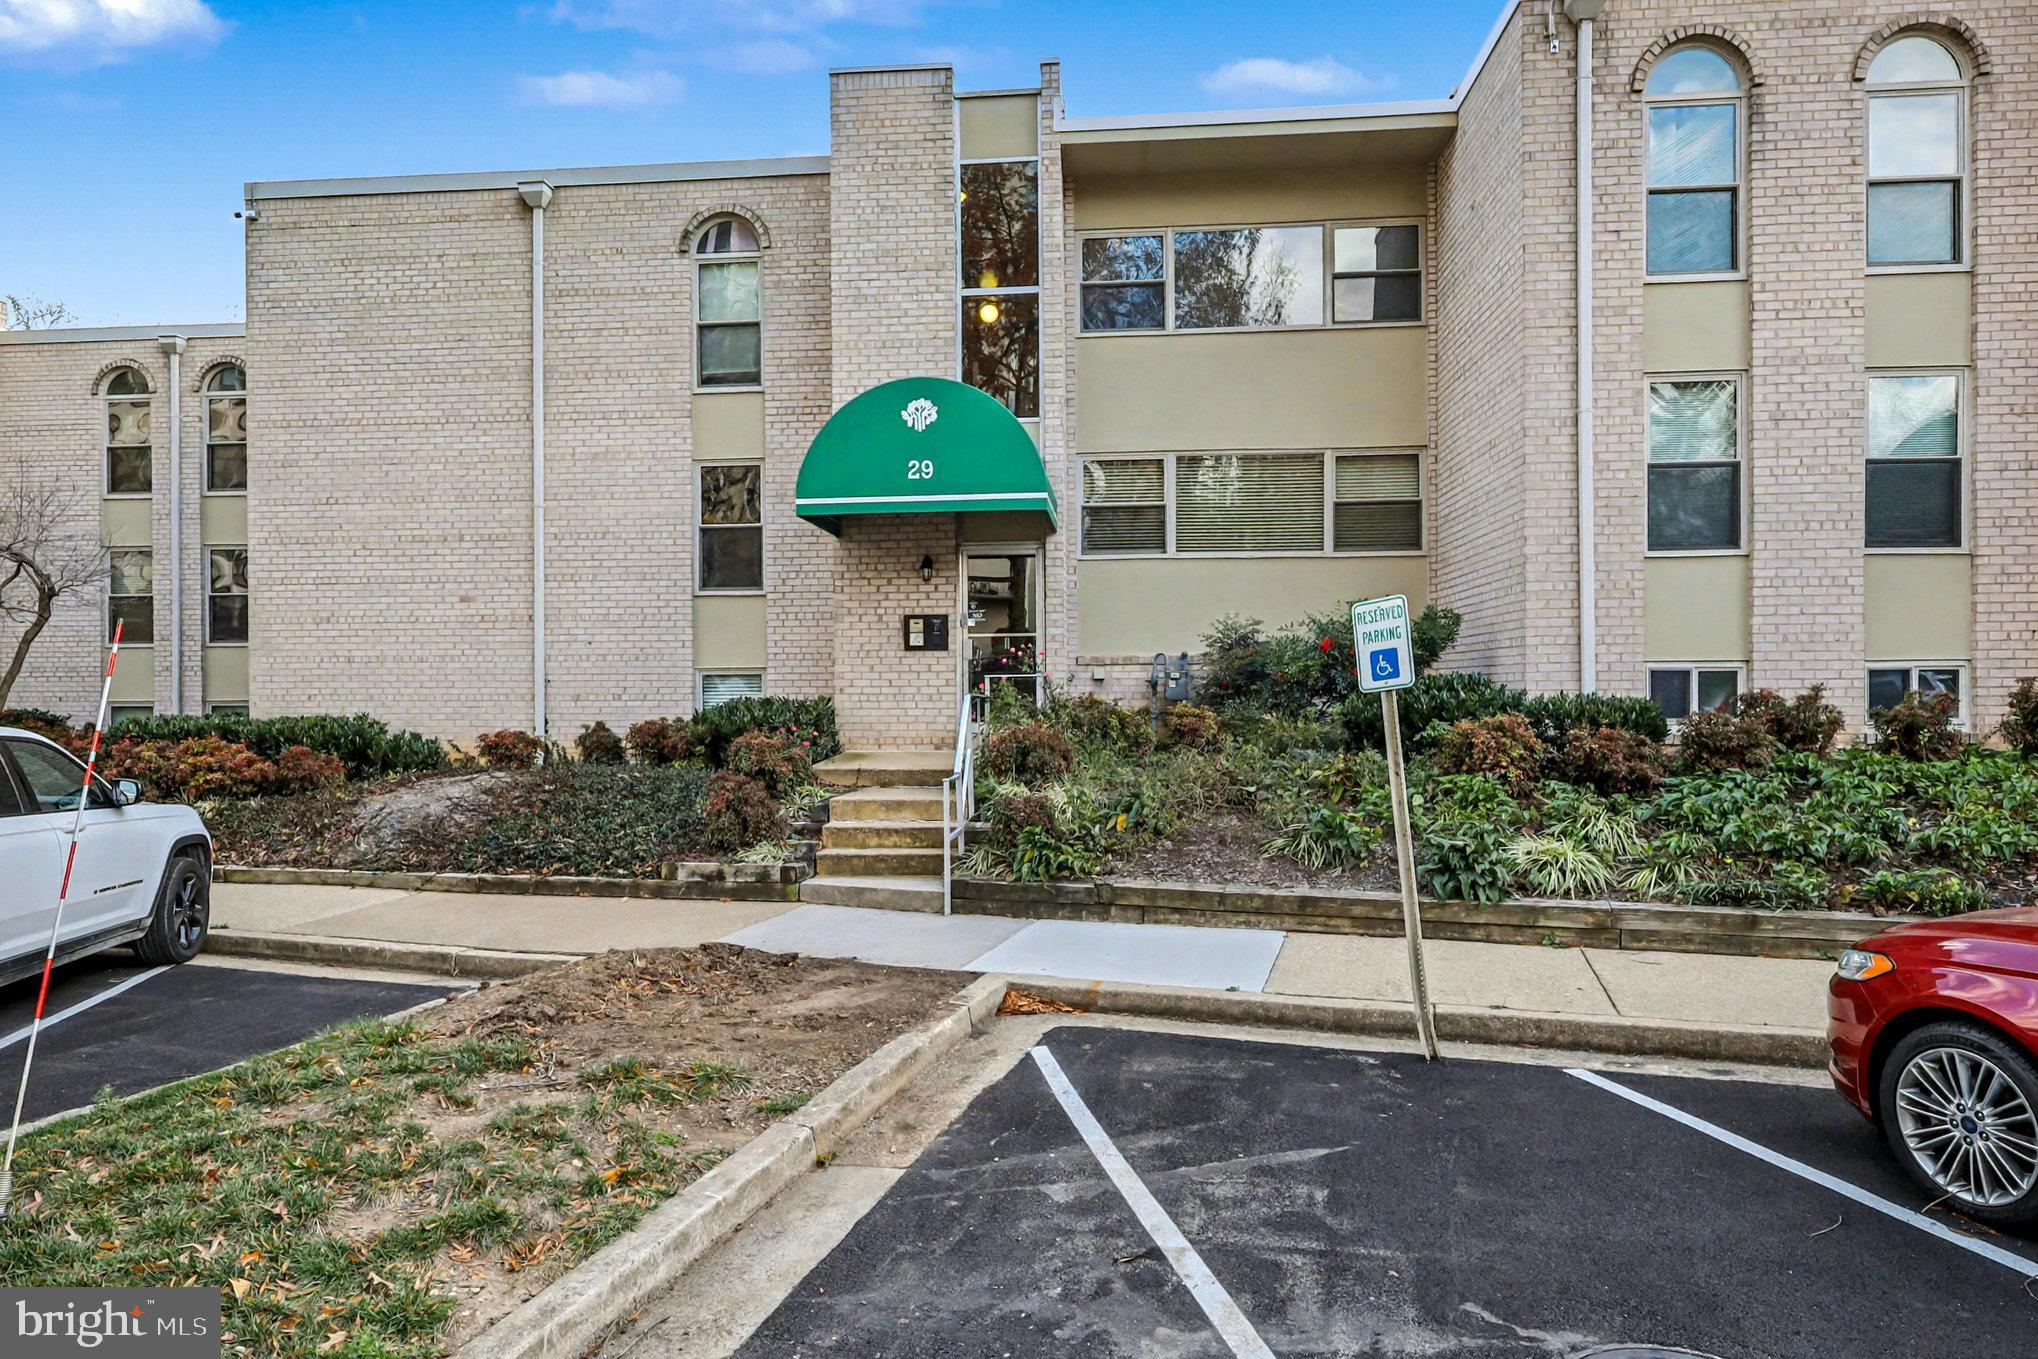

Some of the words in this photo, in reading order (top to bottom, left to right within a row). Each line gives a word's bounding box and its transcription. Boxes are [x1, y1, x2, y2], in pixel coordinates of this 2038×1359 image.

[907, 460, 934, 479] 29
[1357, 605, 1403, 625] RESERVED
[1363, 626, 1402, 645] PARKING
